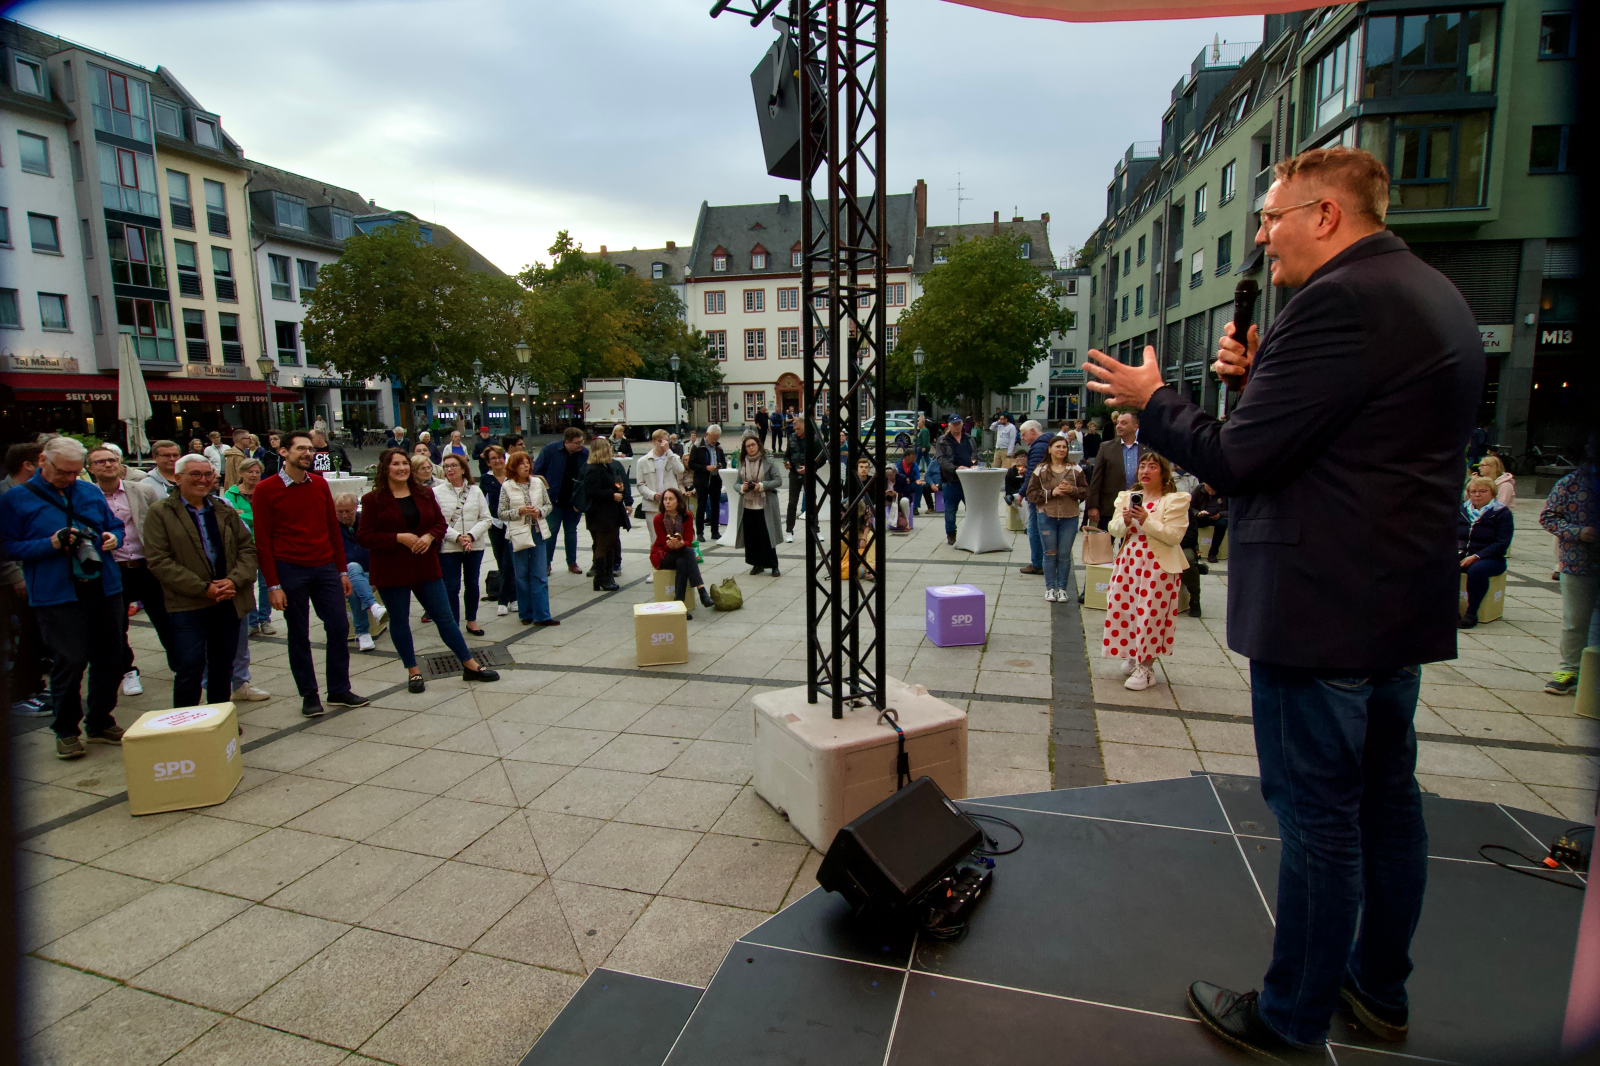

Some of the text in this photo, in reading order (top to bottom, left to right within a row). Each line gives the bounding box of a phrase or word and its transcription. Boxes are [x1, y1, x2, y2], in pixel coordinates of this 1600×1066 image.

[1480, 331, 1495, 339] TZ
[1541, 330, 1573, 344] M13
[14, 357, 60, 367] Taj Mahal
[65, 393, 112, 401] SEIT 1991
[170, 394, 200, 402] MAHAL
[1201, 537, 1213, 545] SP
[665, 585, 676, 594] SP
[1095, 582, 1108, 591] SP
[951, 614, 973, 625] SPD
[650, 632, 675, 643] SPD
[153, 759, 196, 778] SPD
